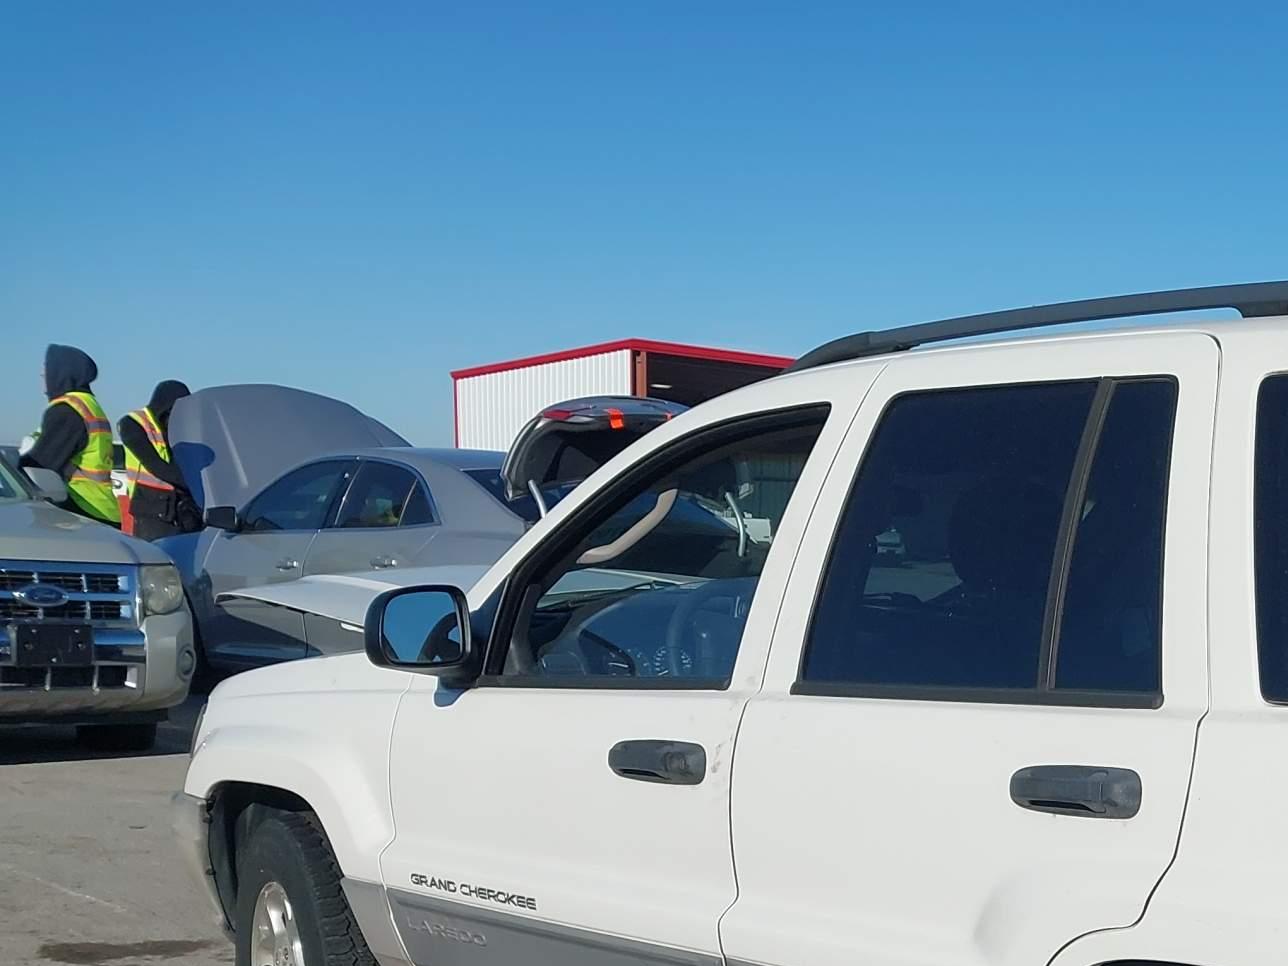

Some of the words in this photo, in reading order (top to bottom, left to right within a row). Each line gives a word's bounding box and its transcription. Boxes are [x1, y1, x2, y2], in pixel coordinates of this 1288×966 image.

[409, 873, 457, 893] GRAND
[459, 883, 537, 911] CHEROKEE
[406, 915, 488, 948] LAREDO
